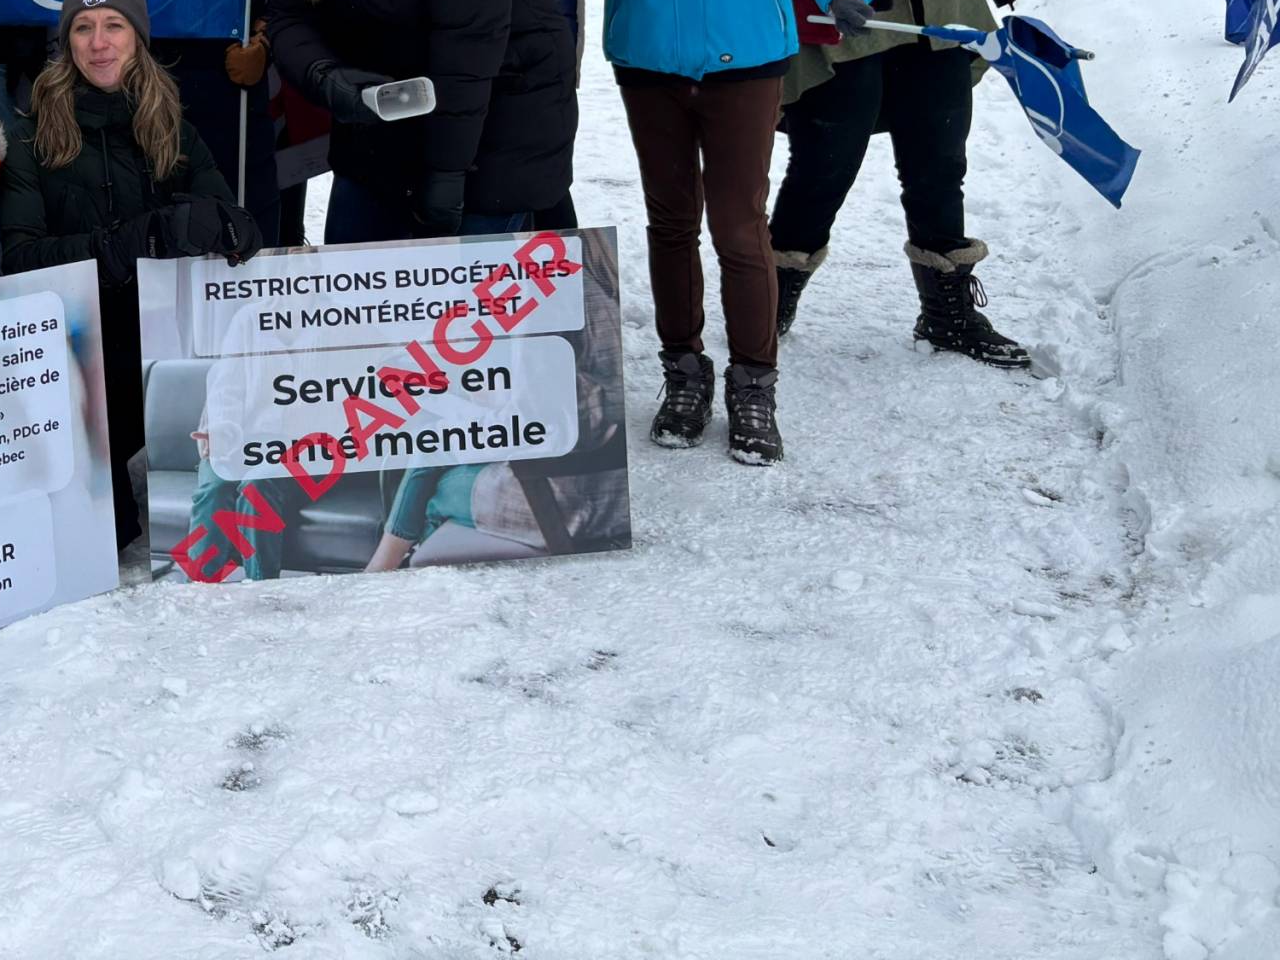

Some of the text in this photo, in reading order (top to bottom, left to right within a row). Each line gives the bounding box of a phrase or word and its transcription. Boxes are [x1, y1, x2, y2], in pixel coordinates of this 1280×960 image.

[204, 258, 571, 300] RESTRICTIONS BUDGÉTAIRES
[1, 321, 37, 340] faire
[41, 318, 58, 331] sa
[259, 295, 522, 330] EN MONTÉRÉGIE-EST
[2, 347, 44, 366] saine
[40, 369, 60, 384] de
[273, 365, 511, 405] Services en
[170, 231, 582, 584] EN DANGER
[13, 424, 40, 441] PDG
[44, 419, 60, 432] de
[243, 415, 546, 465] santé mentale
